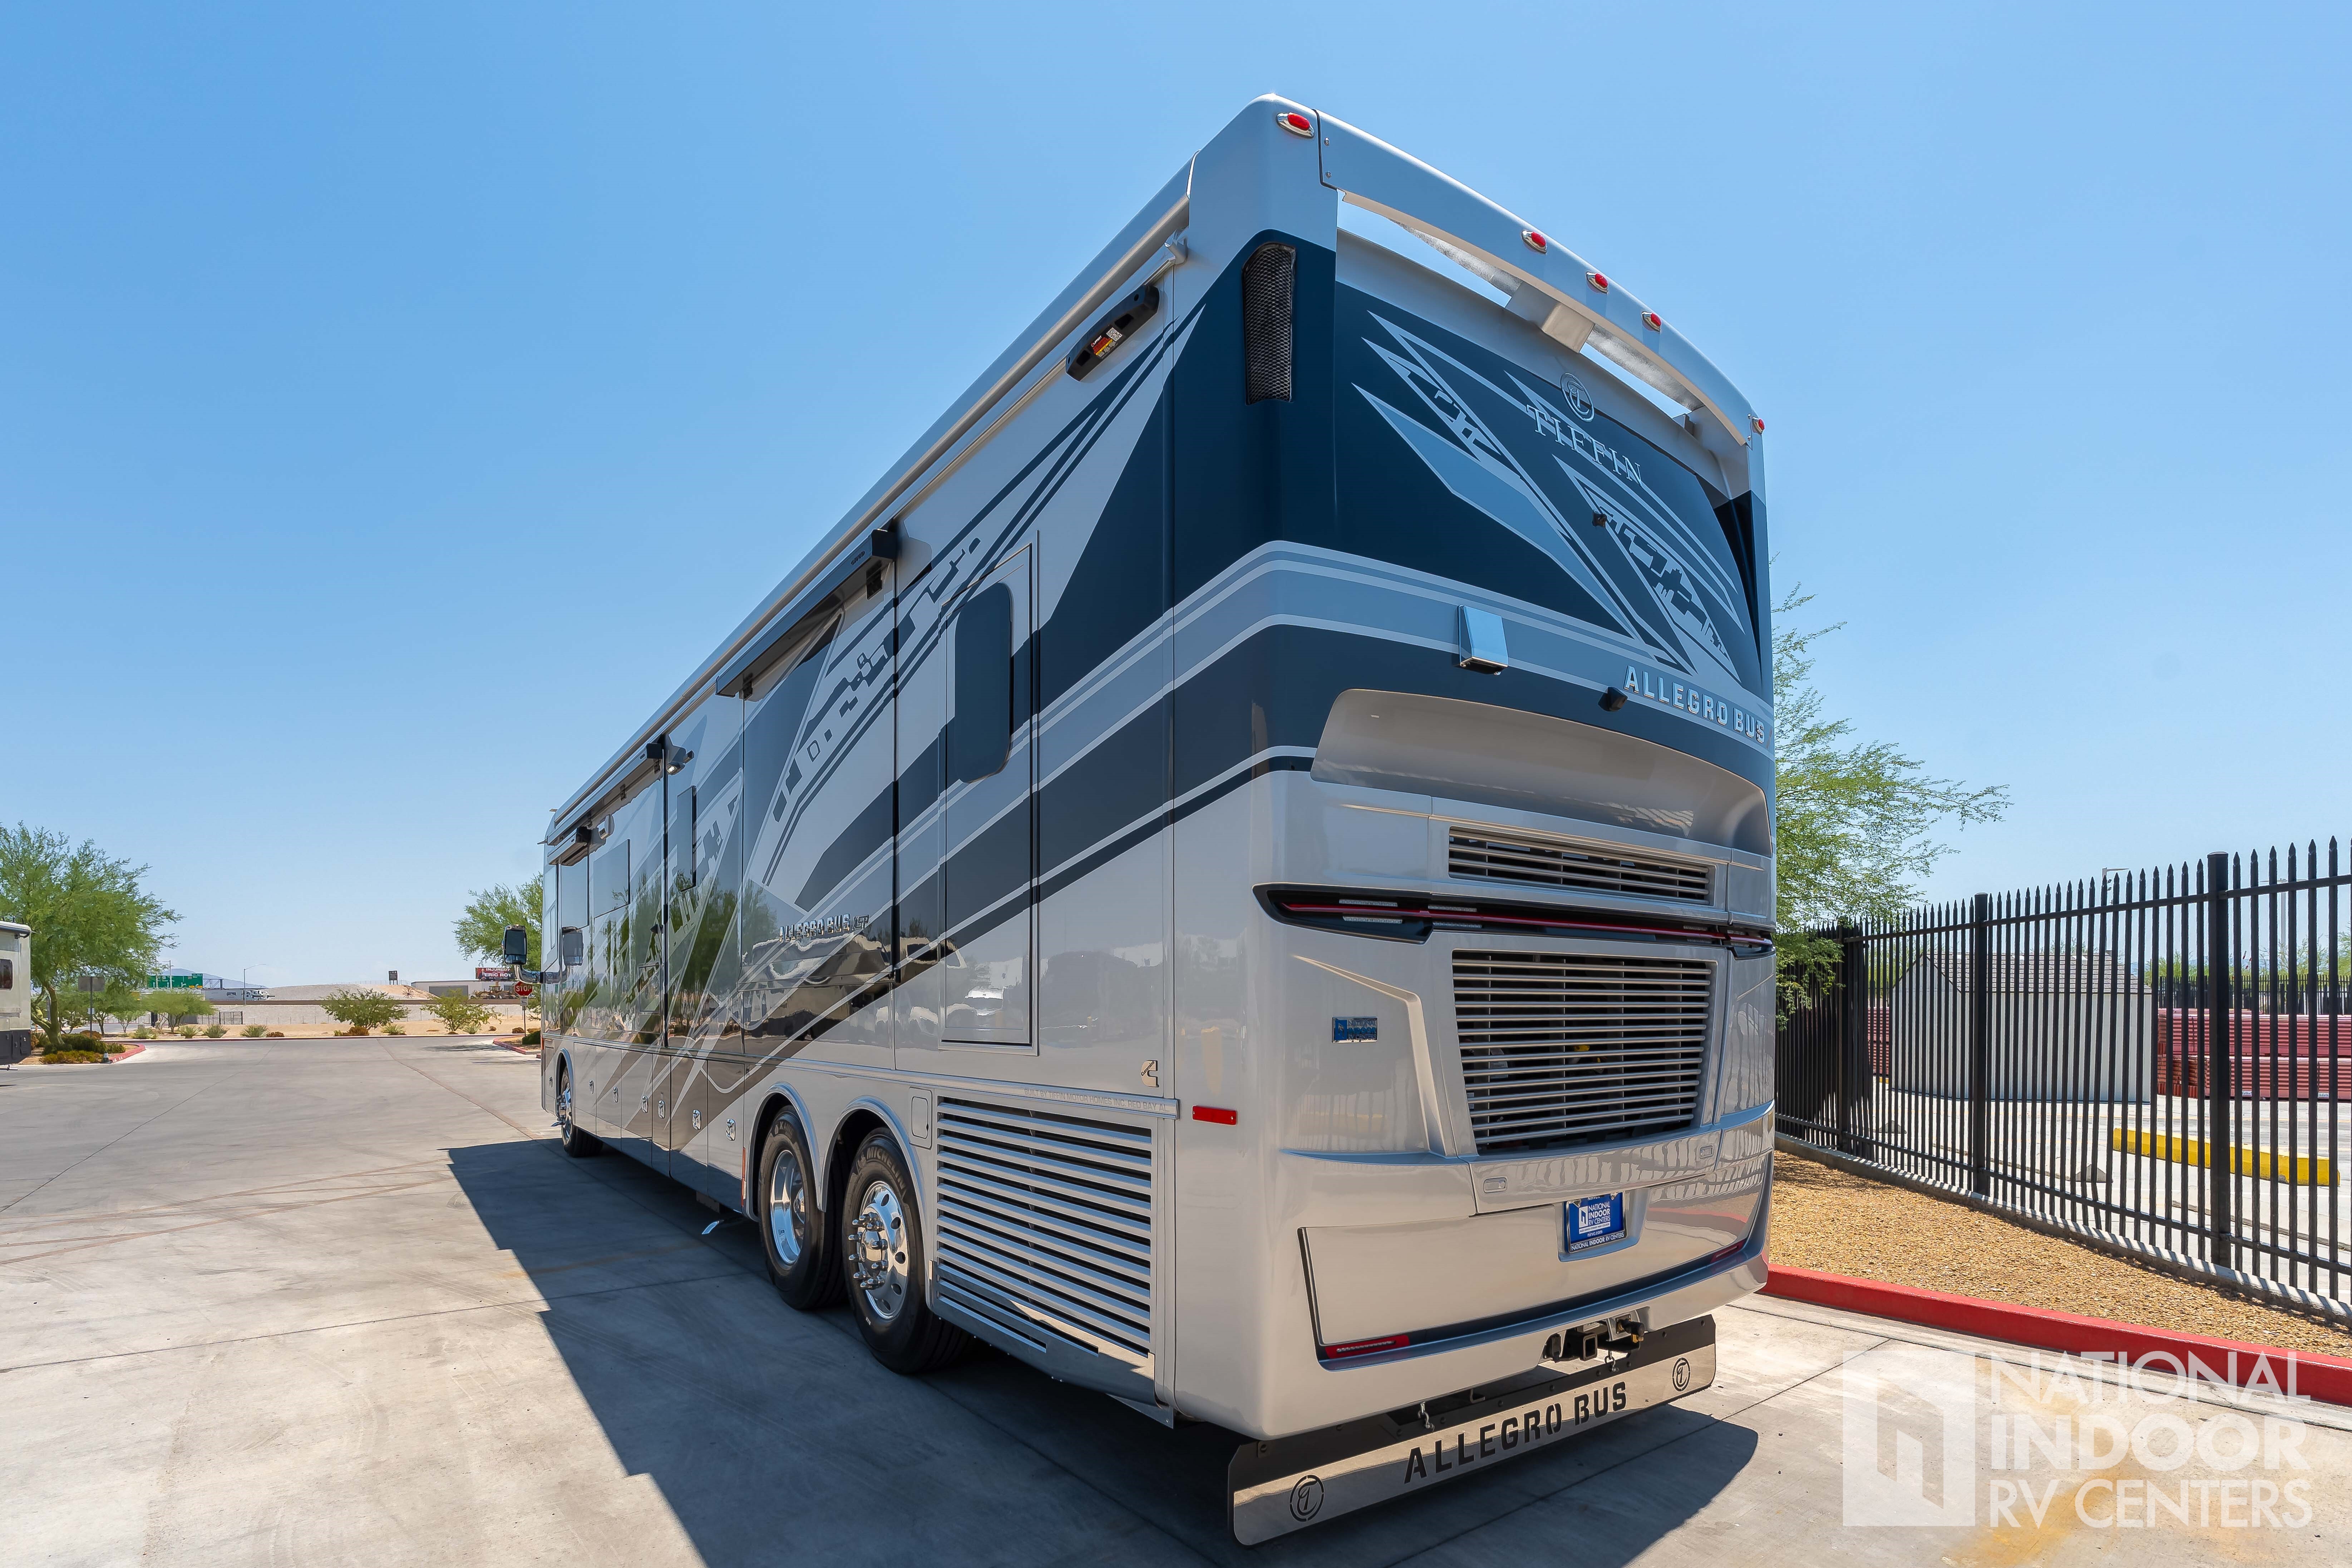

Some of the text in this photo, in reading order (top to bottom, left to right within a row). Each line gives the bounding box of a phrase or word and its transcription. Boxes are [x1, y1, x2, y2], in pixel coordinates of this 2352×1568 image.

[1526, 404, 1642, 487] TIFFIN
[1623, 665, 1765, 744] ALLEGRO BUS
[779, 918, 824, 942] ALLEGRO
[827, 913, 850, 934] BUS
[1141, 1061, 1154, 1076] Cummins
[1048, 1091, 1065, 1099] TIFFIN
[1067, 1093, 1088, 1102] MOTOR
[1090, 1095, 1112, 1105] HOMES
[1113, 1098, 1126, 1106] INC.
[1128, 1100, 1141, 1108] RED
[1144, 1102, 1157, 1110] BAY
[867, 1147, 906, 1190] MICHELIN
[1588, 1201, 1610, 1212] NATIONAL
[1589, 1208, 1610, 1219] INDOOR
[1594, 1215, 1611, 1224] CENTERS
[1571, 1242, 1588, 1251] NATIONAL
[1589, 1237, 1605, 1245] INDOOR
[1404, 1381, 1626, 1484] ALLEGRO BUS
